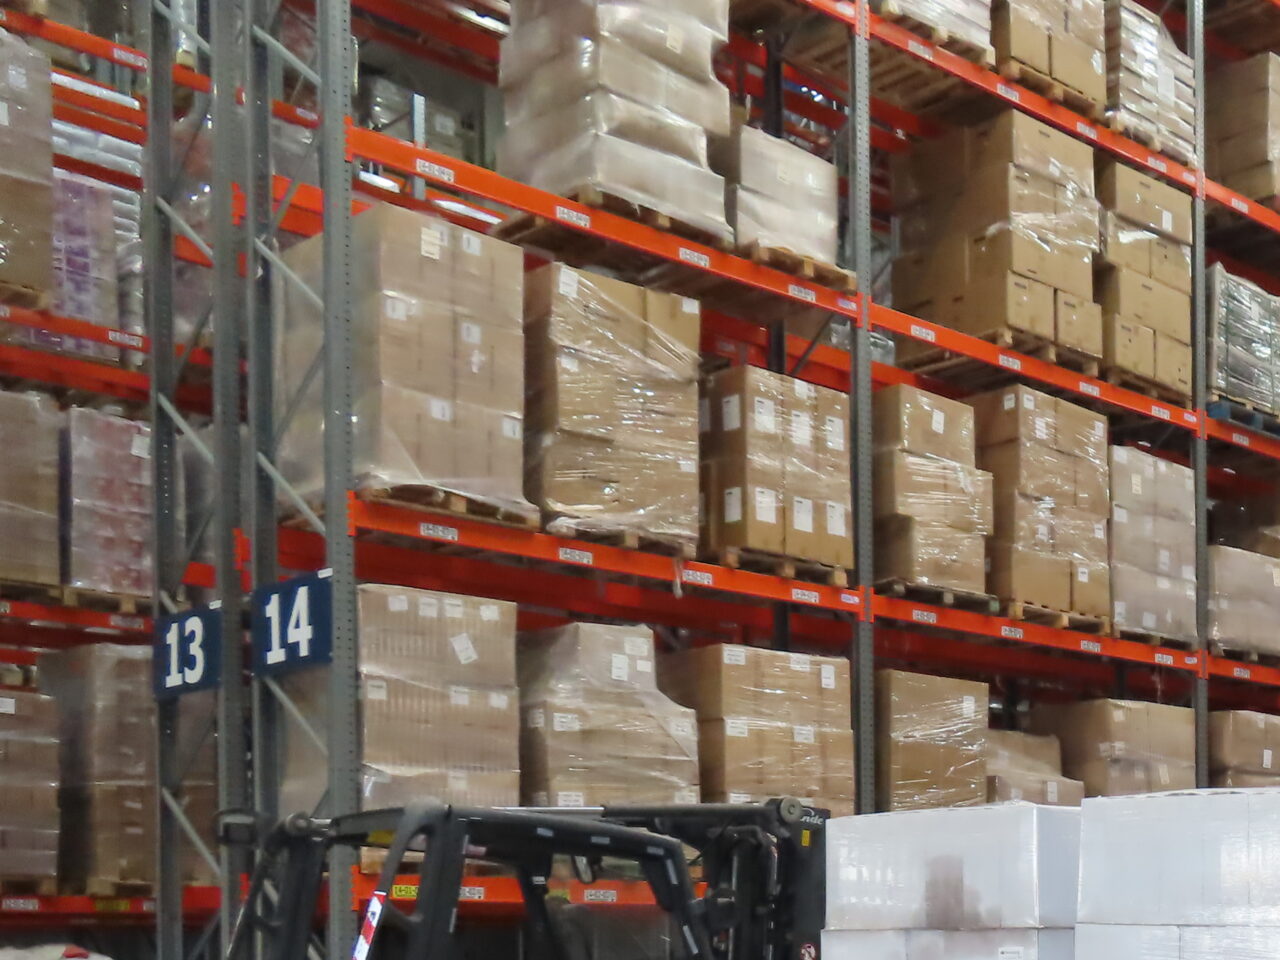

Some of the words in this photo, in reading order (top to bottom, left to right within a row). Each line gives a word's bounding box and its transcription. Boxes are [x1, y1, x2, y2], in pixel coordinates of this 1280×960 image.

[165, 616, 204, 688] 13
[265, 586, 313, 664] 14
[800, 807, 824, 825] nde
